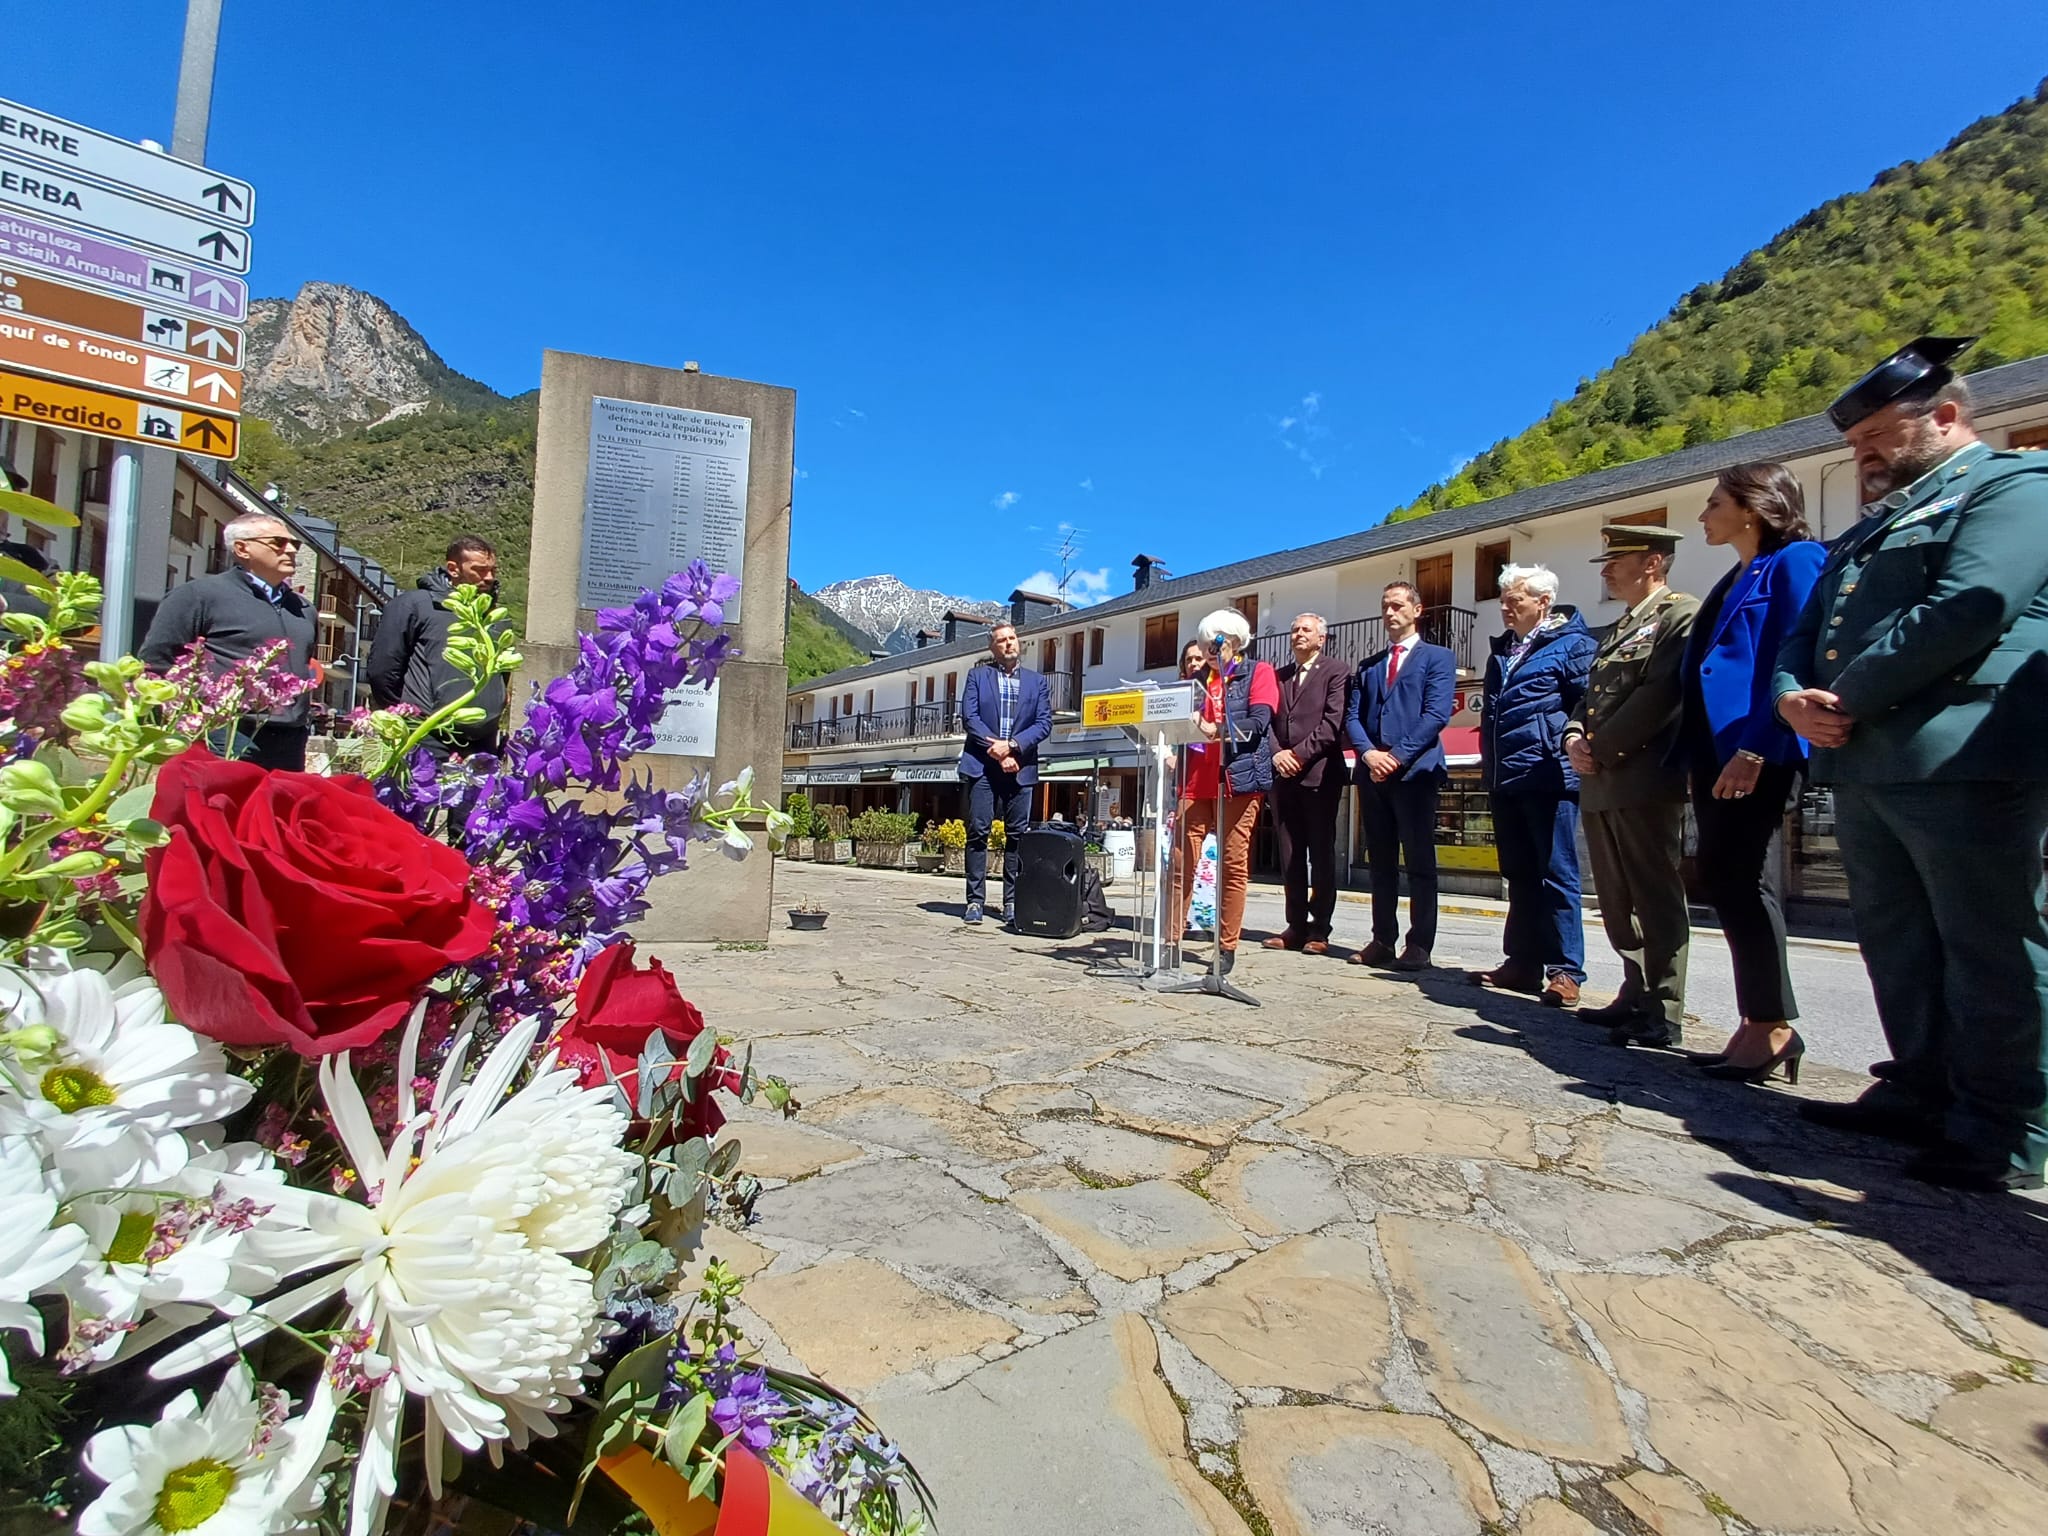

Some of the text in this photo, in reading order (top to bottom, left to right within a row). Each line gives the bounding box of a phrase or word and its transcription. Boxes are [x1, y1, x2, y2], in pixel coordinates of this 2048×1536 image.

[0, 115, 79, 157] ERRE
[1, 170, 82, 211] ERBA
[0, 271, 18, 288] e
[64, 255, 143, 287] Armajani
[42, 333, 71, 349] de
[78, 339, 140, 365] fondo
[13, 393, 123, 431] Perdido
[600, 402, 638, 415] Muertos
[666, 412, 688, 422] Valle
[690, 416, 702, 424] de
[704, 418, 730, 428] Bielsa
[608, 414, 644, 425] defensa
[661, 421, 670, 429] la
[672, 422, 717, 436] República
[719, 430, 725, 438] y
[727, 430, 735, 438] la
[615, 424, 727, 448] Democracia (1936-1939)
